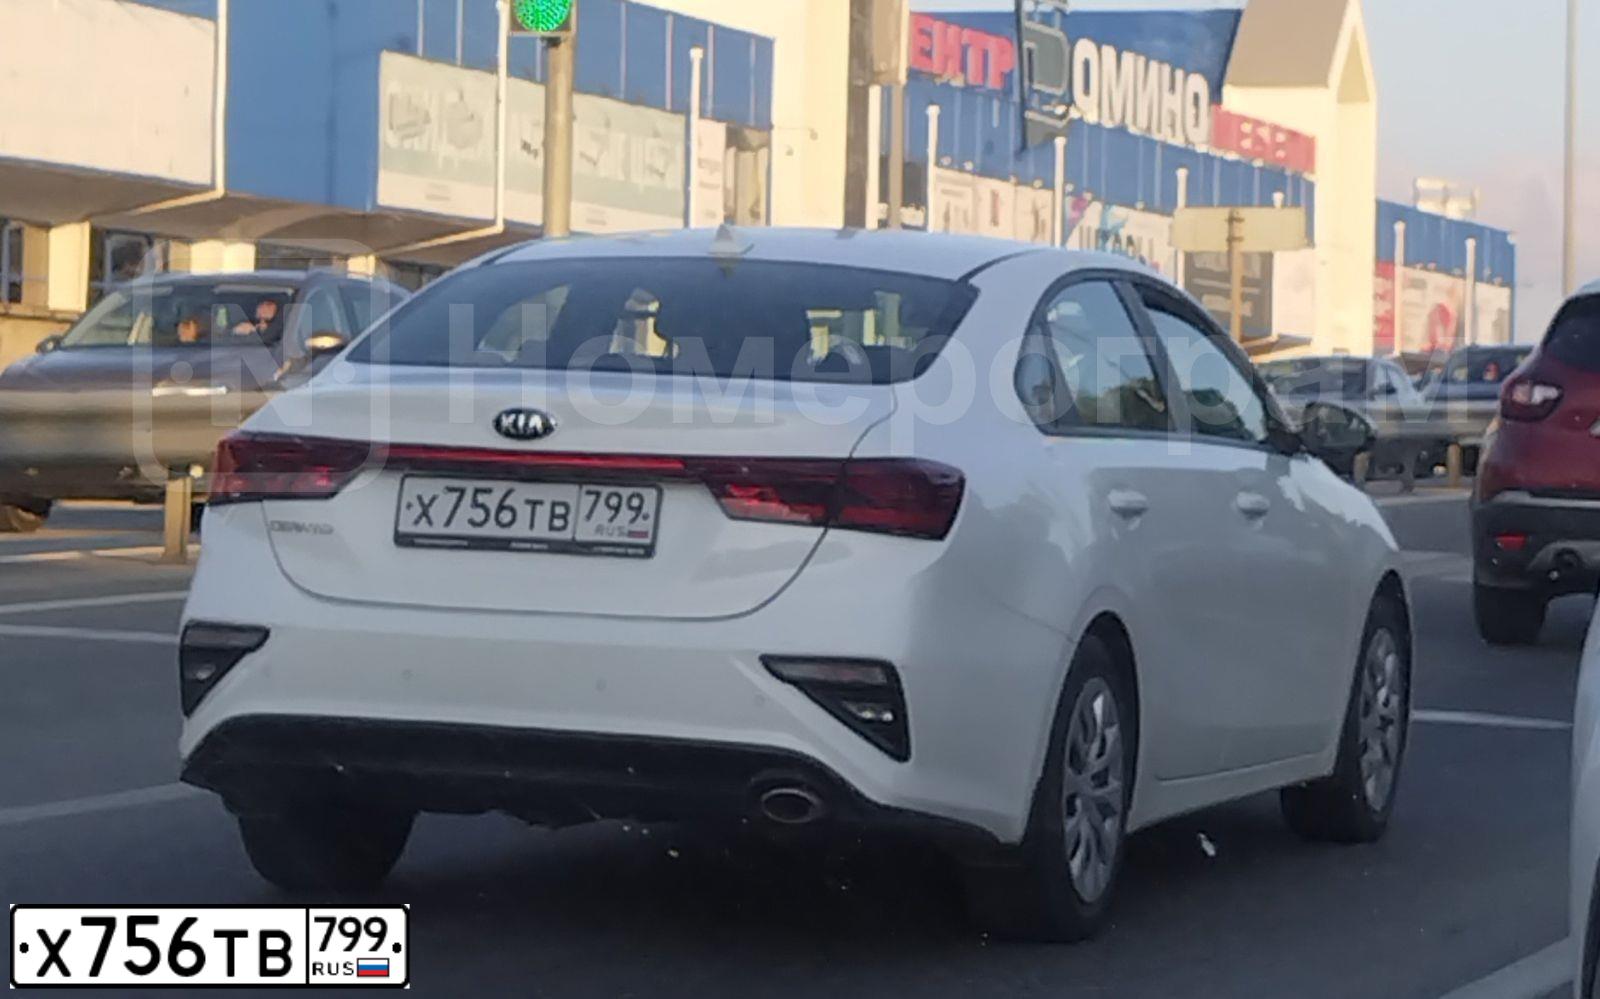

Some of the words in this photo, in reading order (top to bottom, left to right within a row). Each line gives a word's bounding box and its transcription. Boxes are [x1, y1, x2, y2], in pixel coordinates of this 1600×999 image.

[909, 12, 1015, 91] ЕНТР
[501, 412, 544, 435] KIA
[585, 489, 645, 524] 799
